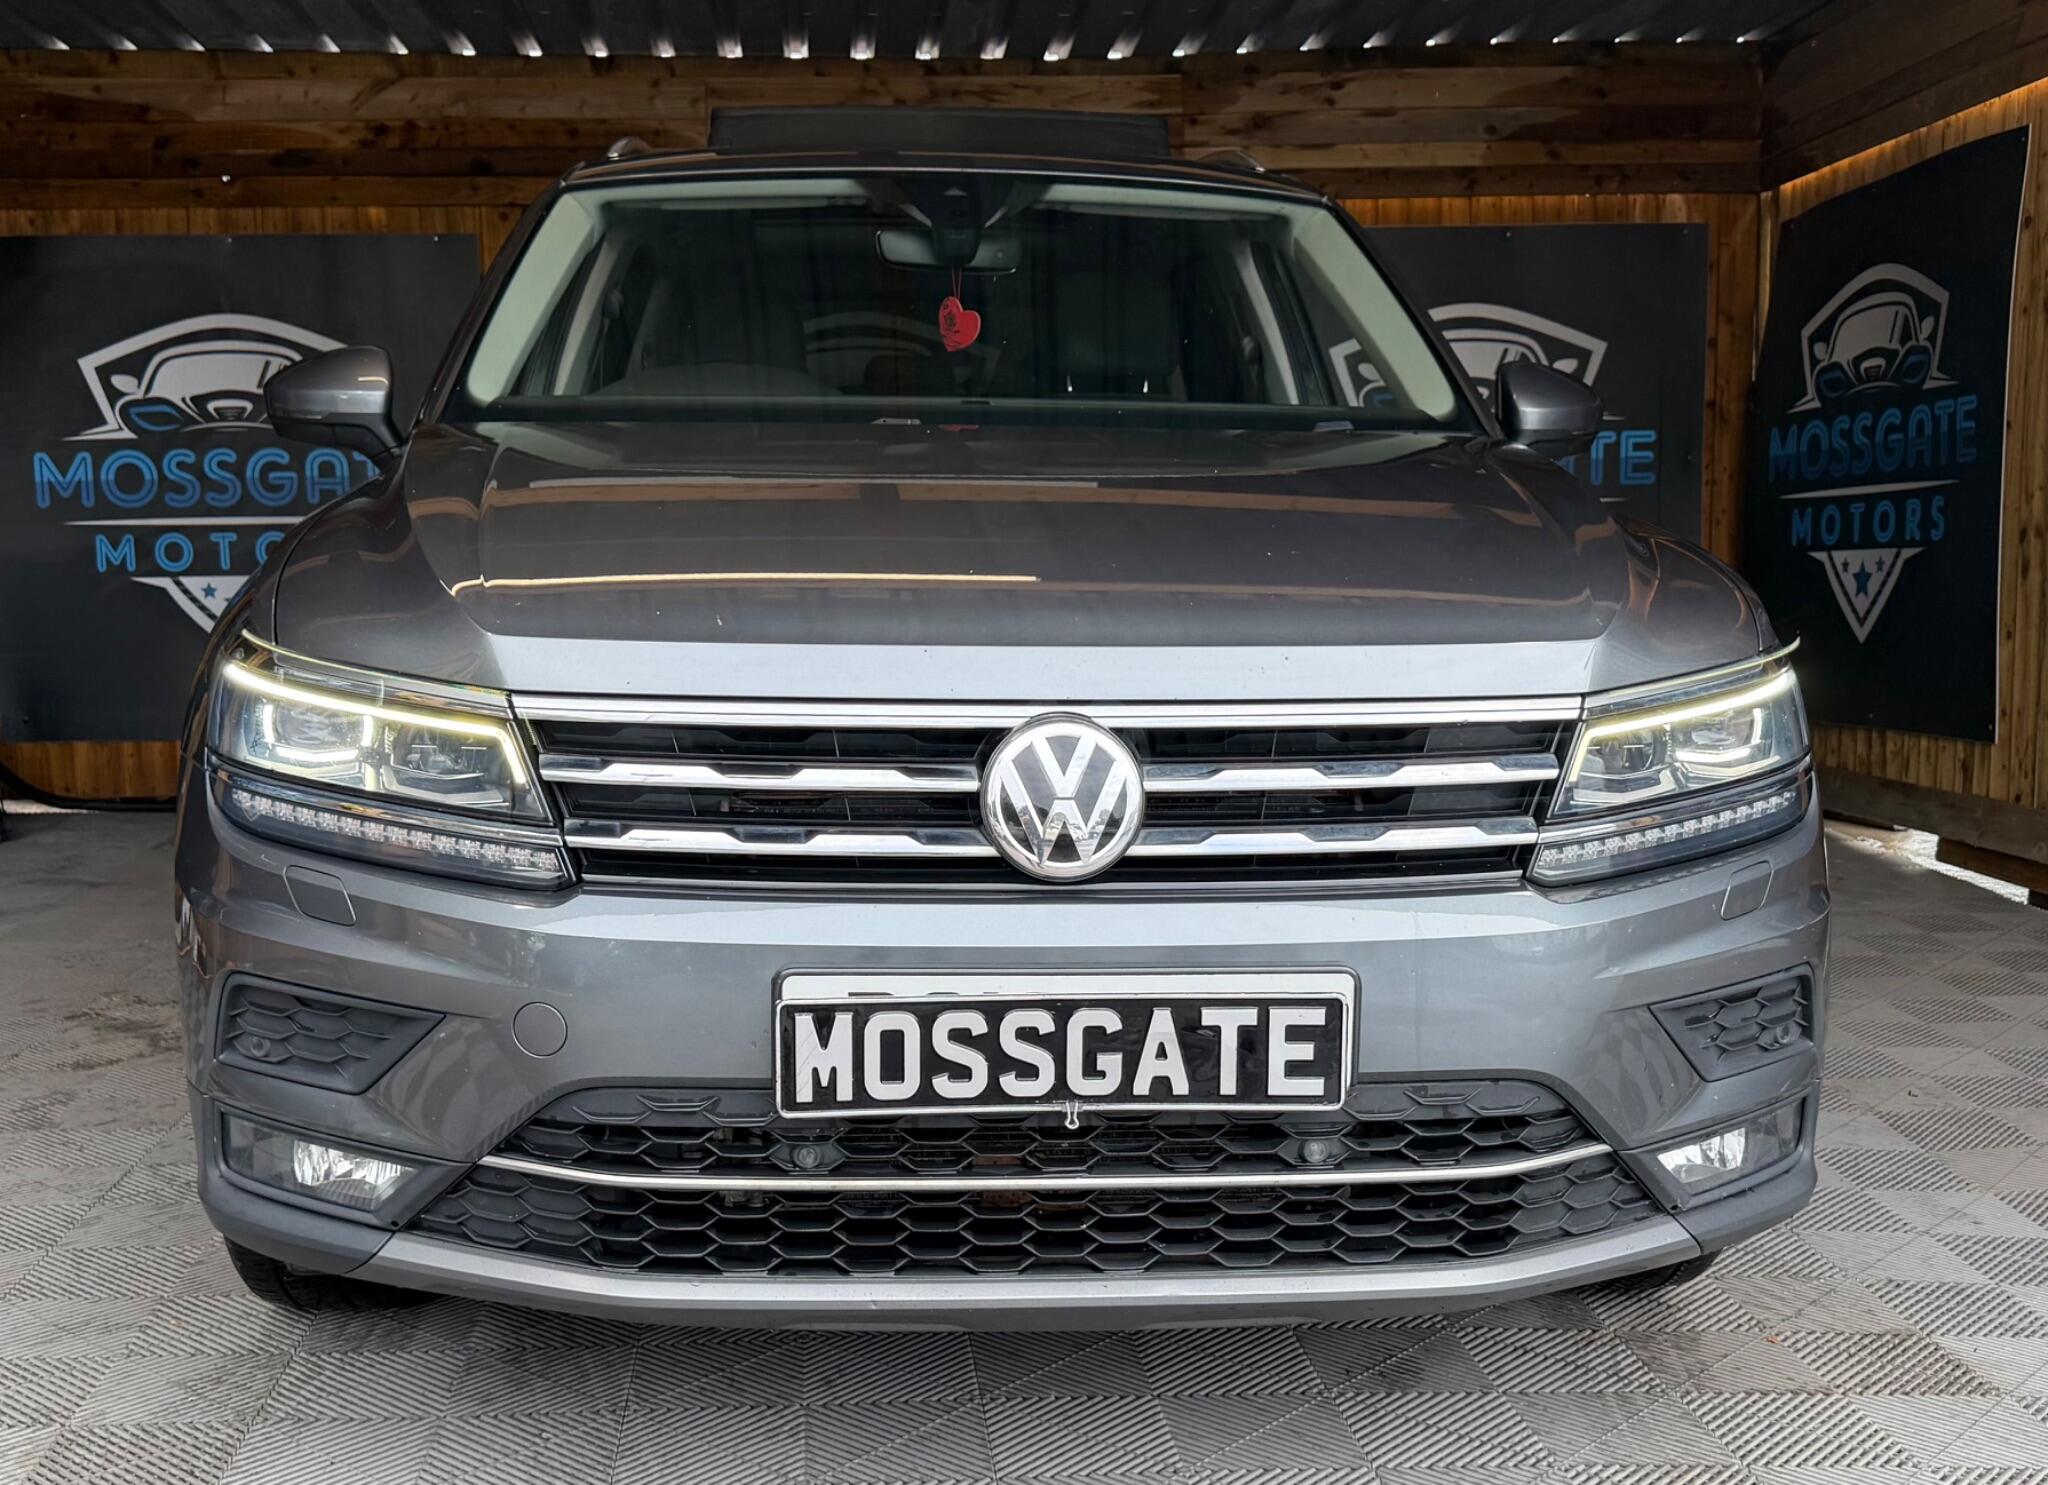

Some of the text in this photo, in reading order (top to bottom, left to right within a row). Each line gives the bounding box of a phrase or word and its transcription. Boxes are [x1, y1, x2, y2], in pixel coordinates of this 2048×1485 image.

[1552, 430, 1657, 486] TE
[1768, 395, 1978, 483] MOSSGATE
[1791, 496, 1945, 547] MOTORS
[993, 729, 1133, 868] VW
[794, 1007, 1327, 1103] MOSSGATE
